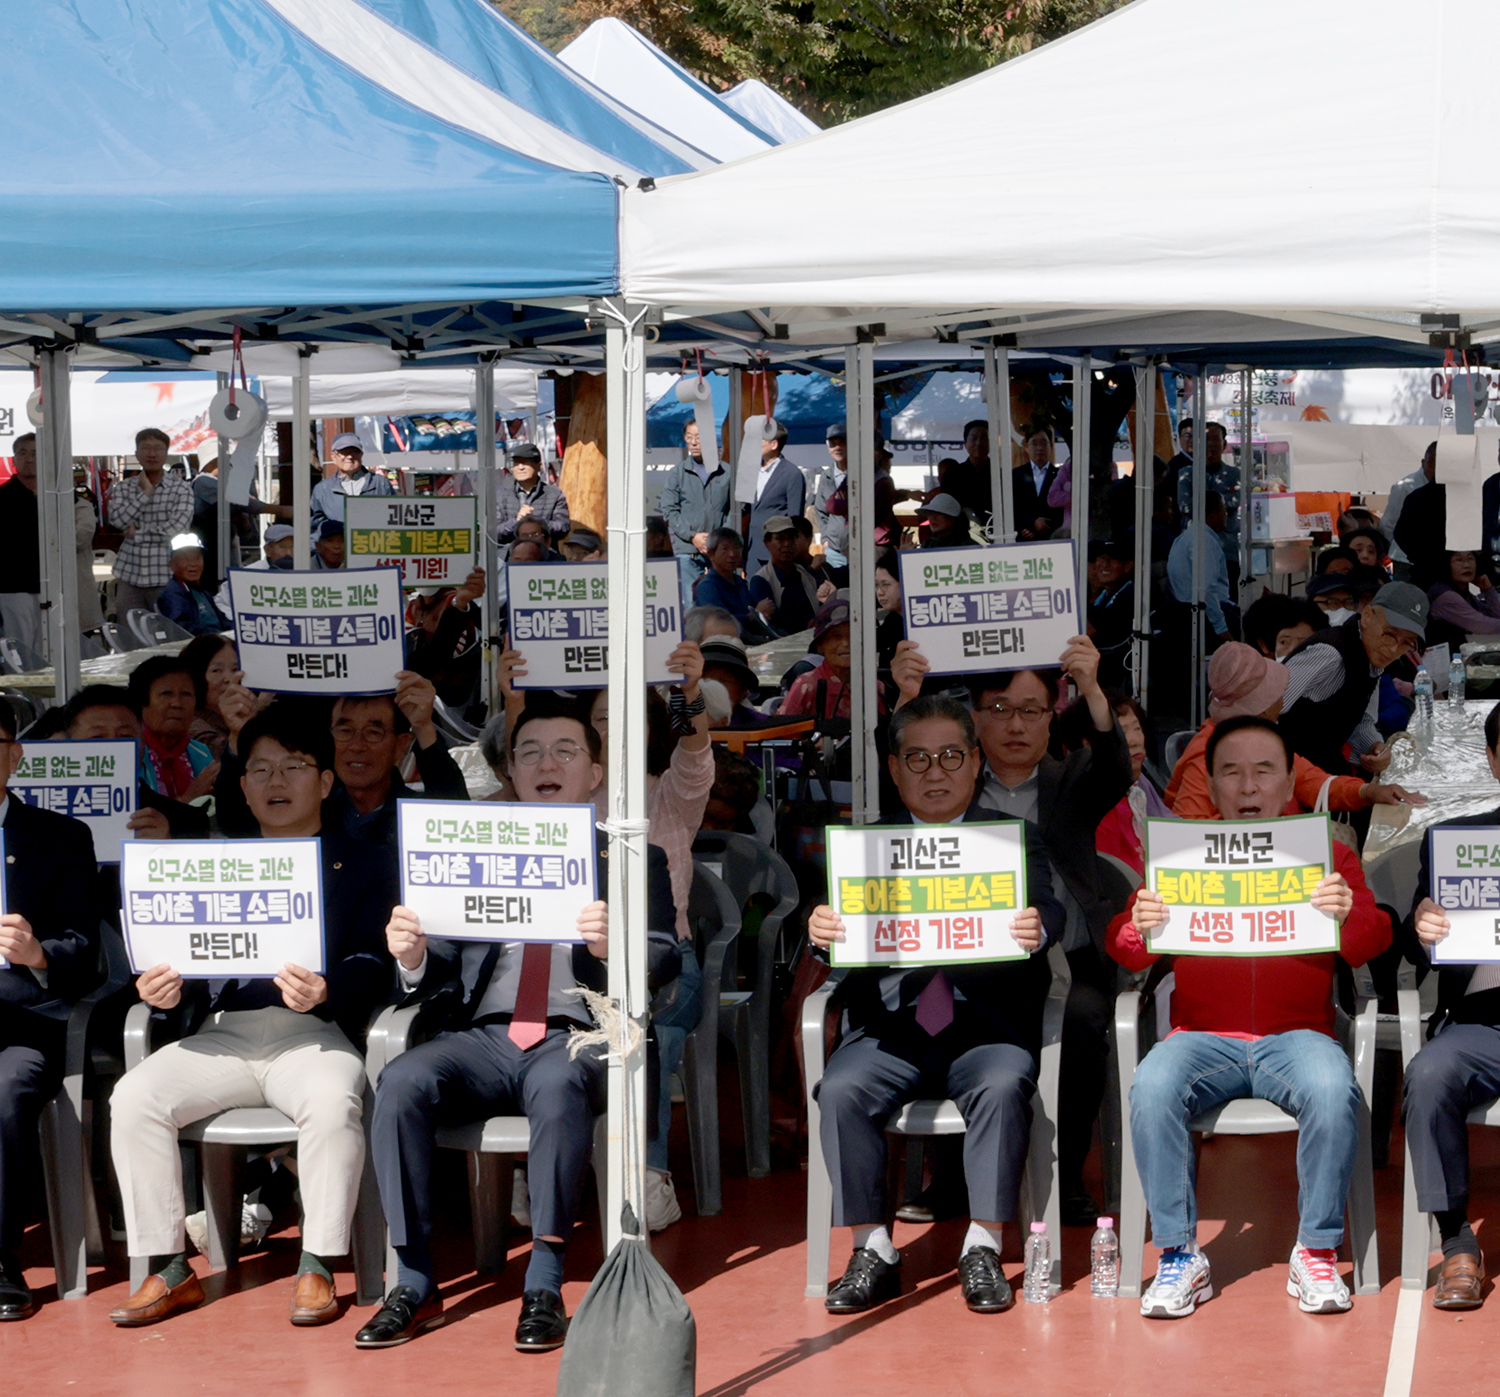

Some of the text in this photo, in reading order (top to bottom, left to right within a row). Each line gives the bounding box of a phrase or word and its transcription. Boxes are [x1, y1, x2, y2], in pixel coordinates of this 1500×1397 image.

[388, 504, 435, 526] 괴산군
[352, 530, 469, 553] 농어촌 기본소득
[412, 558, 448, 579] 기원!
[923, 558, 1053, 587] 인구소멸 없는 괴산
[251, 584, 378, 608] 인구소멸 없는 괴산
[528, 578, 587, 601] 인구소멸
[591, 578, 608, 600] 없
[911, 588, 1072, 625] 농어촌 기본 소득이
[240, 615, 396, 645] 농어촌 기본 소득이
[515, 609, 569, 639] 농어촌
[962, 628, 1025, 657] 만든다!
[287, 653, 348, 678] 만든다!
[51, 756, 81, 778] 없는
[85, 755, 116, 777] 괴산
[31, 787, 68, 814] 기본
[72, 786, 130, 815] 소득이
[426, 819, 568, 846] 인구소멸 없는 괴산
[890, 837, 960, 870] 괴산군
[1205, 832, 1273, 864] 괴산군
[149, 857, 293, 882] 인구소멸 없는 괴산
[409, 853, 587, 887] 농어촌 기본 소득이
[841, 874, 1015, 914] 농어촌 기본소득
[1157, 866, 1323, 904] 농어촌 기본소득
[1440, 877, 1500, 908] 농어촌
[132, 891, 313, 923] 농어촌 기본 소득이
[465, 895, 532, 923] 만든다!
[874, 917, 983, 952] 선정 기원!
[1189, 910, 1295, 943] 선정 기원!
[190, 932, 258, 960] 만든다!
